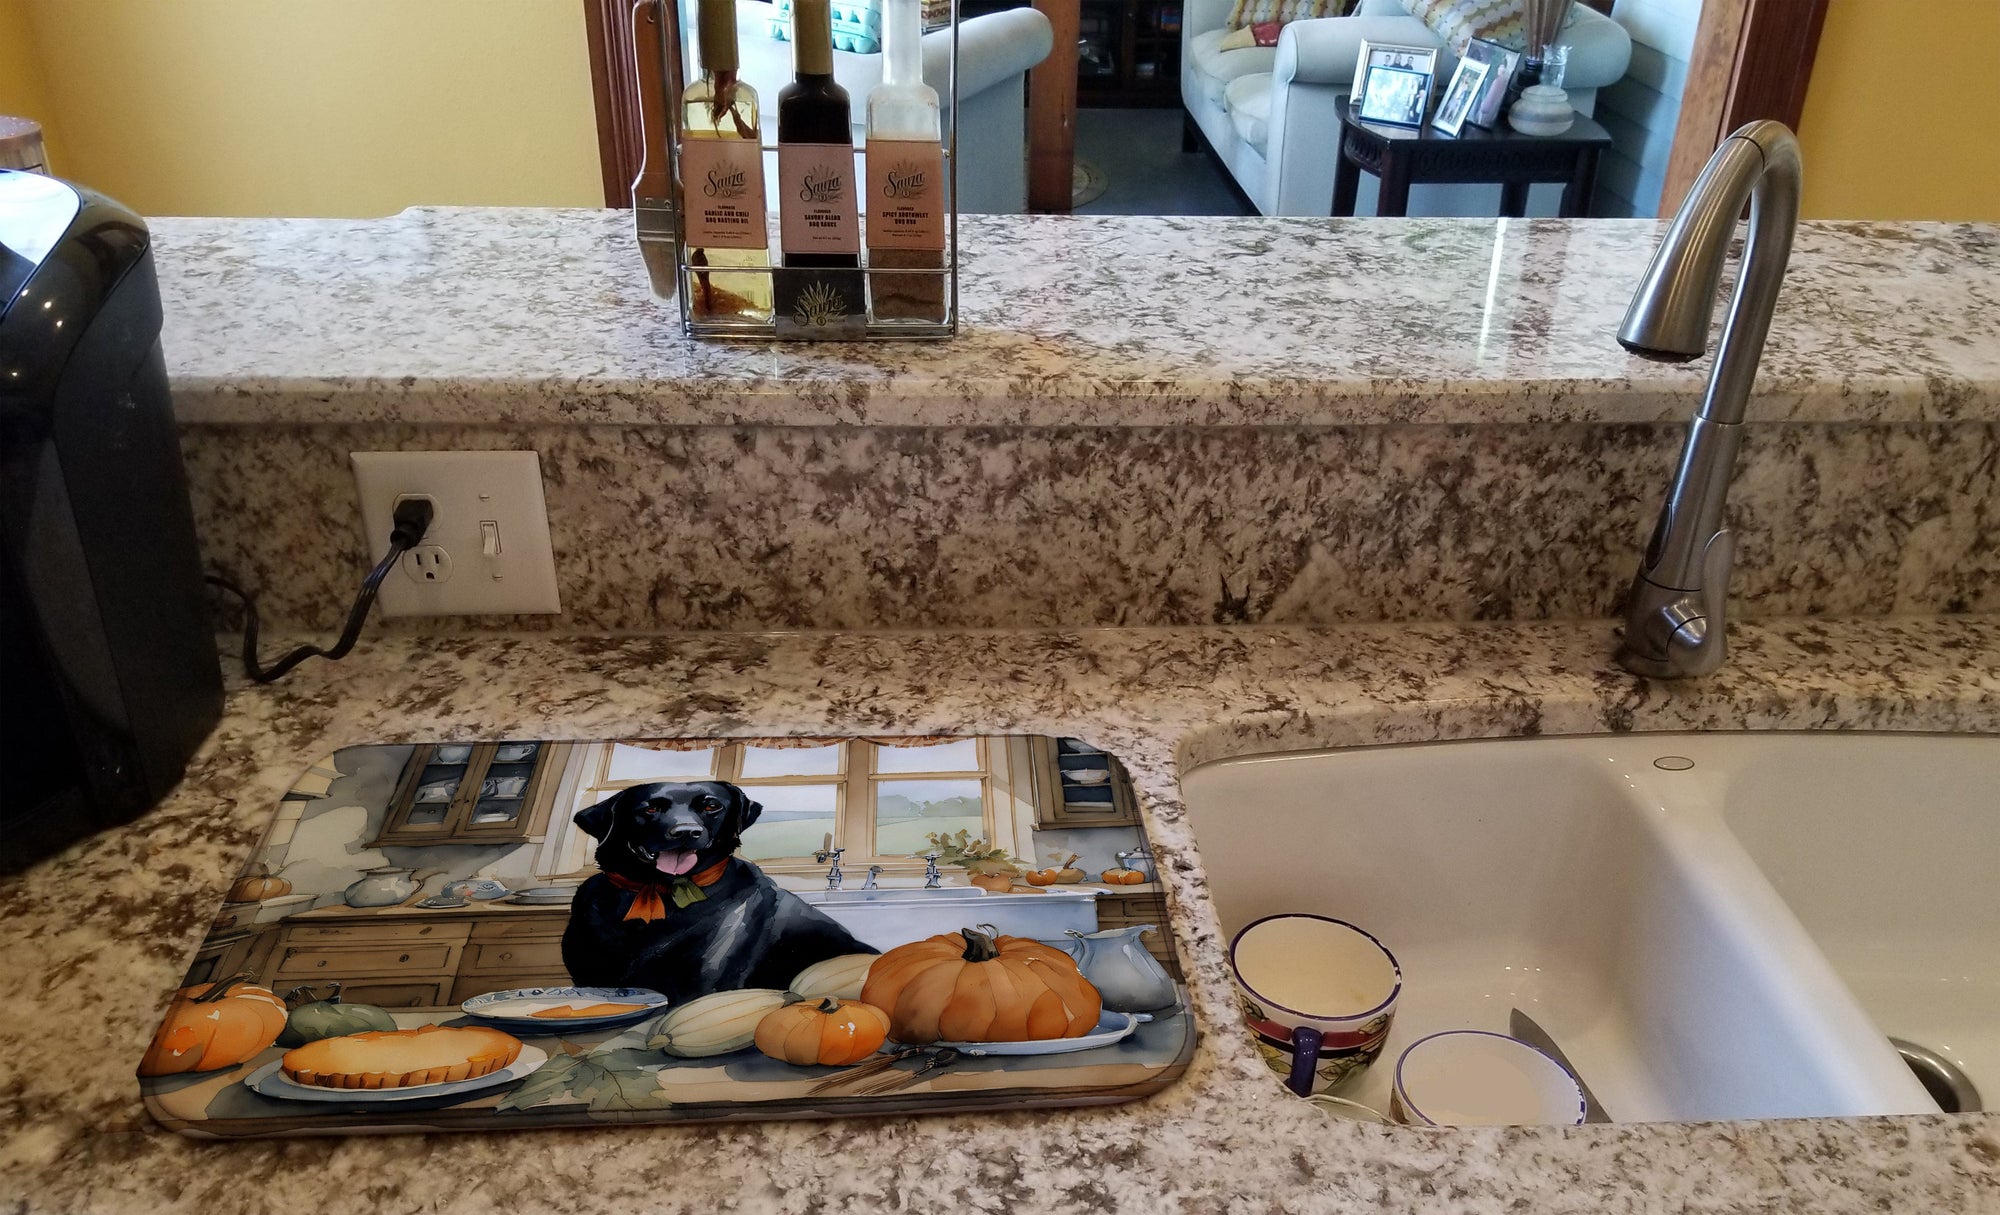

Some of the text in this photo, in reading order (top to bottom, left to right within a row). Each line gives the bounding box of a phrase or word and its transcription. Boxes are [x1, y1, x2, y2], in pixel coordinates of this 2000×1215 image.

[704, 170, 746, 197] Sauza
[800, 175, 841, 202] Sauza
[884, 171, 926, 198] Sauza
